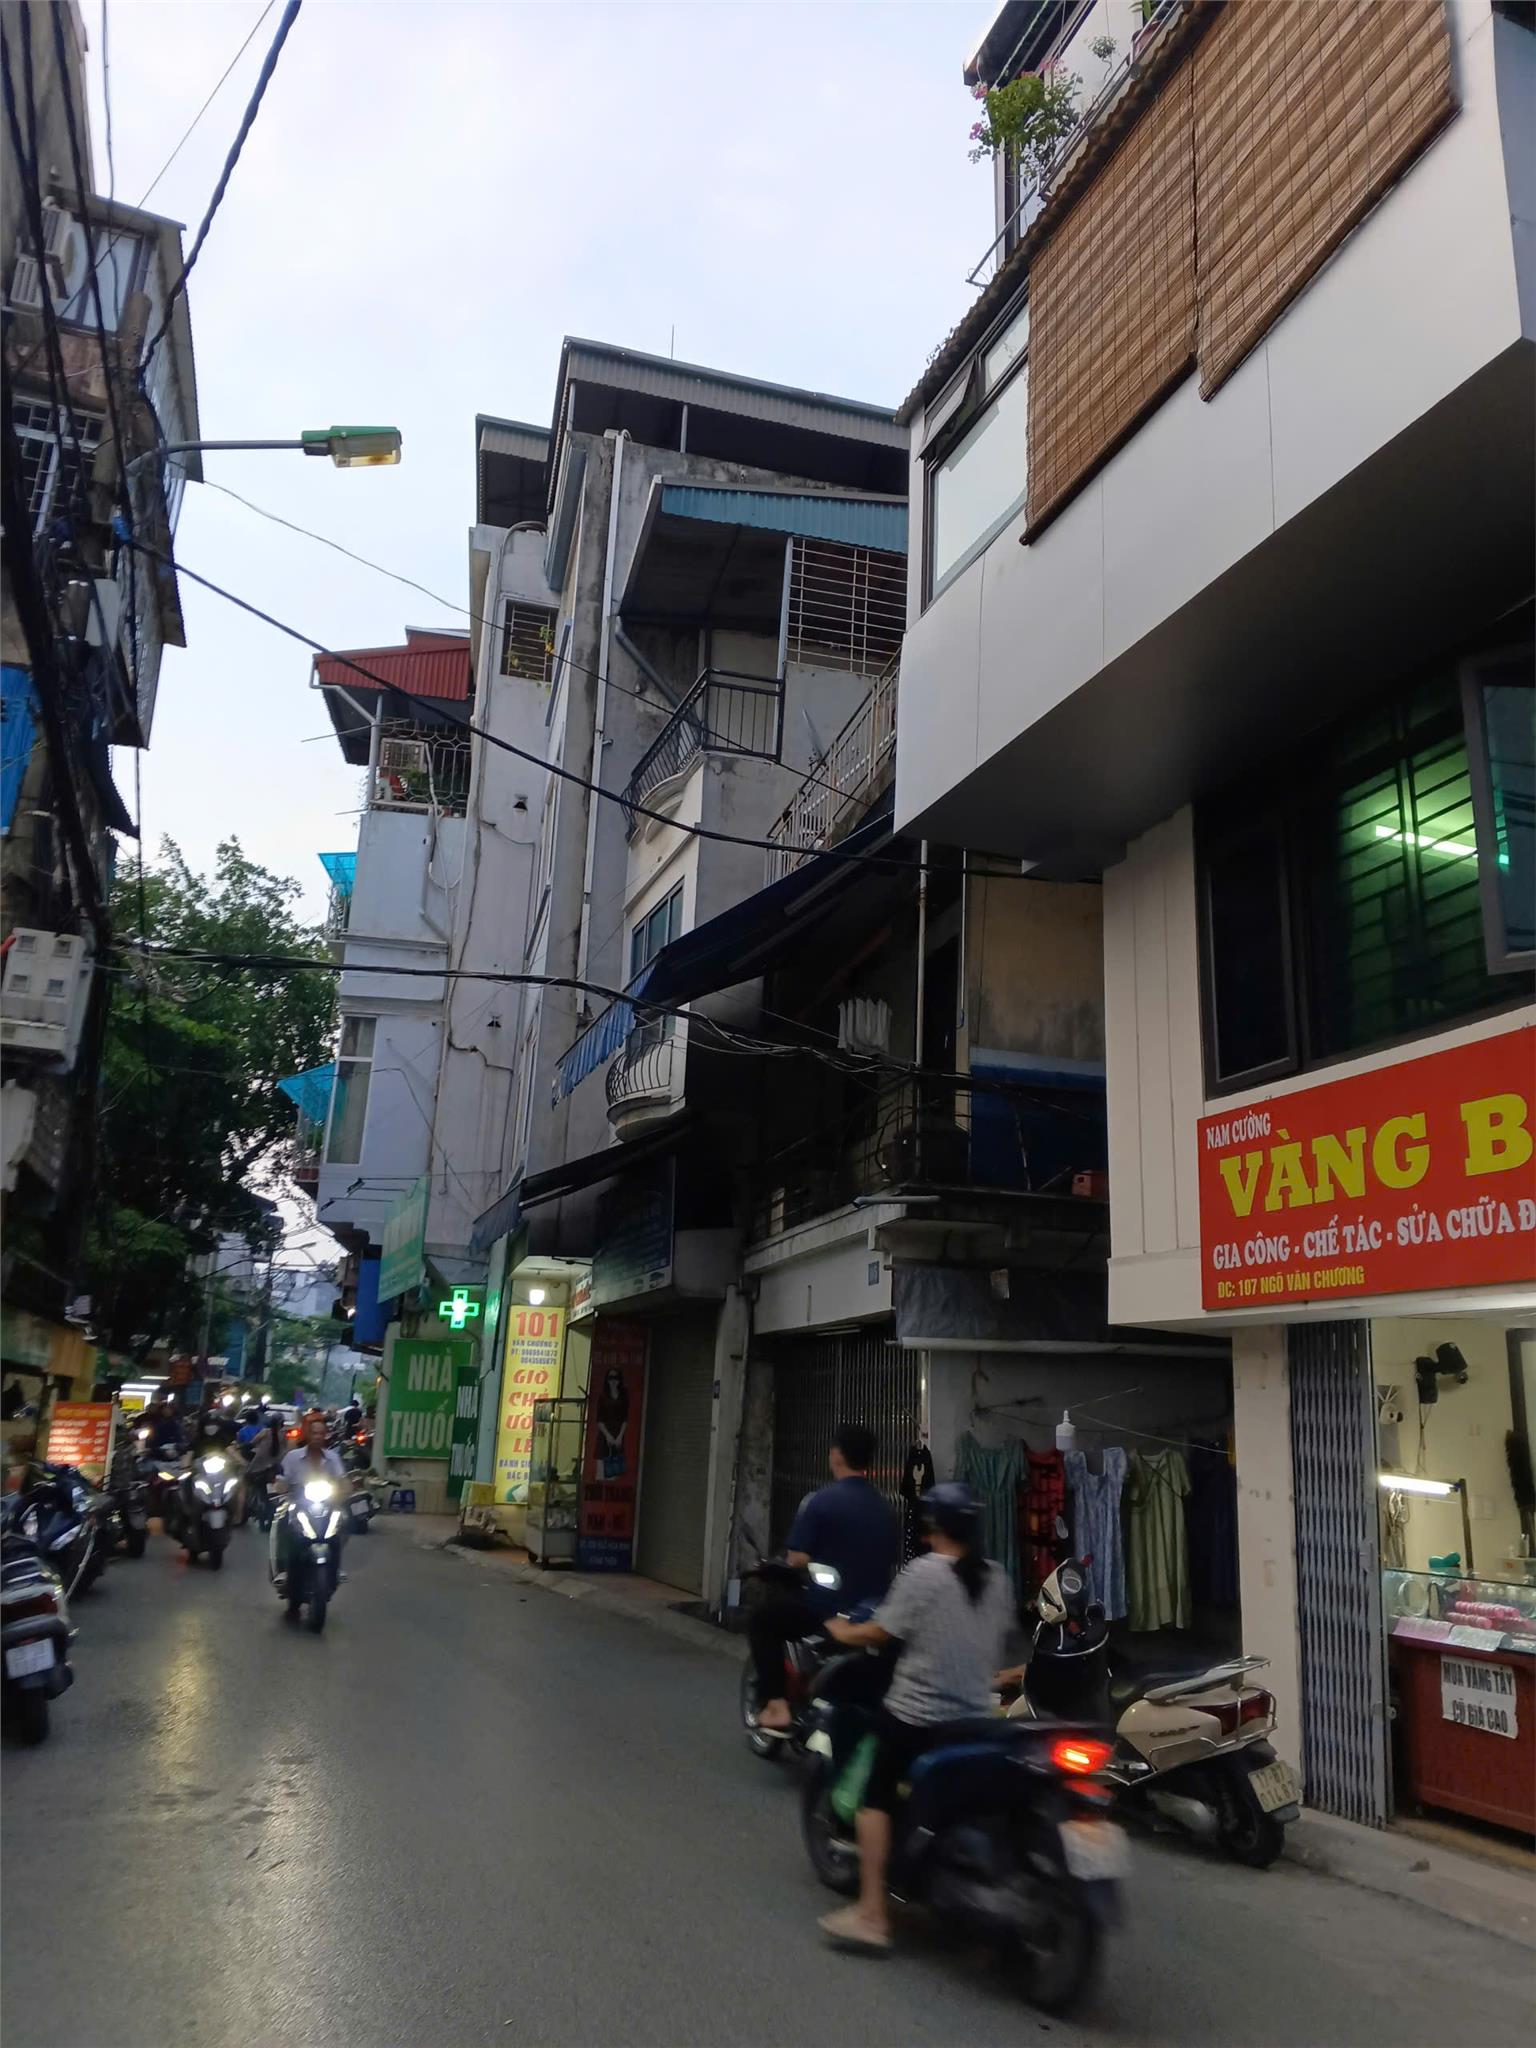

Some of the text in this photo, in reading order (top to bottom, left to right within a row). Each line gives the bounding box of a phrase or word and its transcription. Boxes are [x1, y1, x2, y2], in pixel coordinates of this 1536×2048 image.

[1206, 1109, 1271, 1150] NAM CƯỜNG
[1219, 1093, 1534, 1218] VÀNG B
[1213, 1242, 1242, 1270] GIA
[1244, 1230, 1290, 1266] CÔNG
[1303, 1214, 1340, 1259] CHẾ
[1342, 1215, 1383, 1254] TÁC
[1397, 1203, 1444, 1247] SỬA
[1446, 1195, 1516, 1240] CHỮA
[1239, 1278, 1258, 1296] 107
[1286, 1270, 1311, 1292] VĂN
[1313, 1265, 1365, 1289] CHƯƠNG
[516, 1311, 558, 1338] 101
[407, 1347, 453, 1392] NHÀ
[1443, 1661, 1464, 1687] MUA
[1467, 1701, 1485, 1727] GIÁ
[1486, 1707, 1508, 1734] CAO
